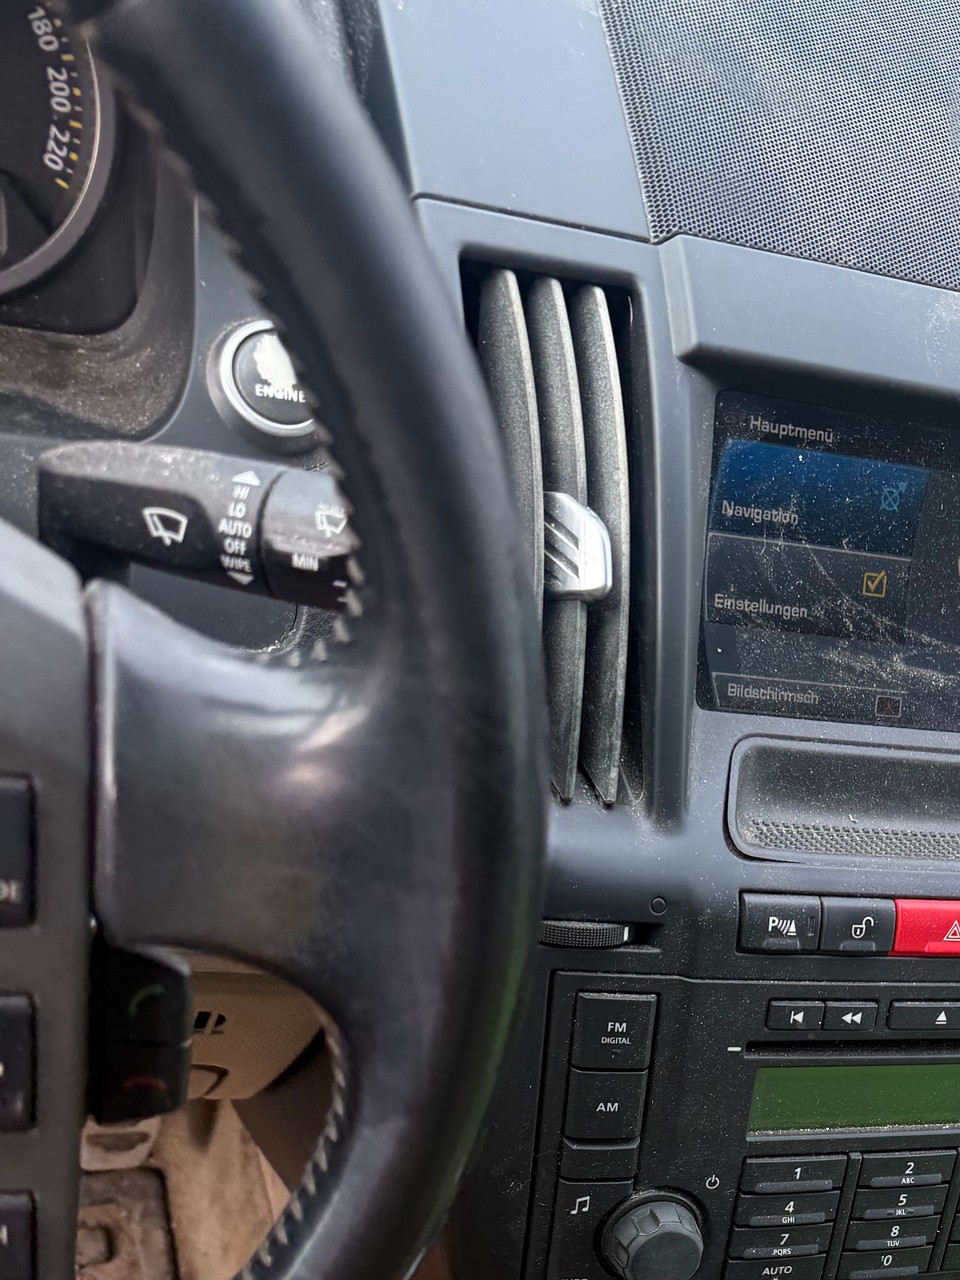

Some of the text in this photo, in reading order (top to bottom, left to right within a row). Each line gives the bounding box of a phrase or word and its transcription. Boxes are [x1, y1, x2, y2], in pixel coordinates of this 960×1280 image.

[28, 6, 60, 51] 180
[46, 66, 72, 113] 200
[43, 124, 70, 171] 220
[750, 416, 834, 443] Hauptmenü
[233, 485, 250, 500] HI
[228, 501, 246, 518] LO
[721, 499, 799, 525] Navigation
[218, 518, 252, 538] AUTO
[223, 537, 247, 555] OFF
[292, 552, 319, 571] MIN
[714, 593, 808, 620] Einstellungen
[607, 1022, 627, 1033] FM
[601, 1036, 632, 1045] DIGITAL
[596, 1102, 619, 1113] AM
[794, 1167, 801, 1180] 1
[905, 1162, 915, 1174] 2
[901, 1177, 915, 1185] ABC
[898, 1194, 908, 1206] 5
[784, 1201, 794, 1213] 4
[782, 1216, 795, 1224] GHI
[890, 1225, 900, 1237] 8
[780, 1233, 790, 1245] 7
[773, 1248, 792, 1256] PQRS
[762, 1266, 793, 1276] AUTO
